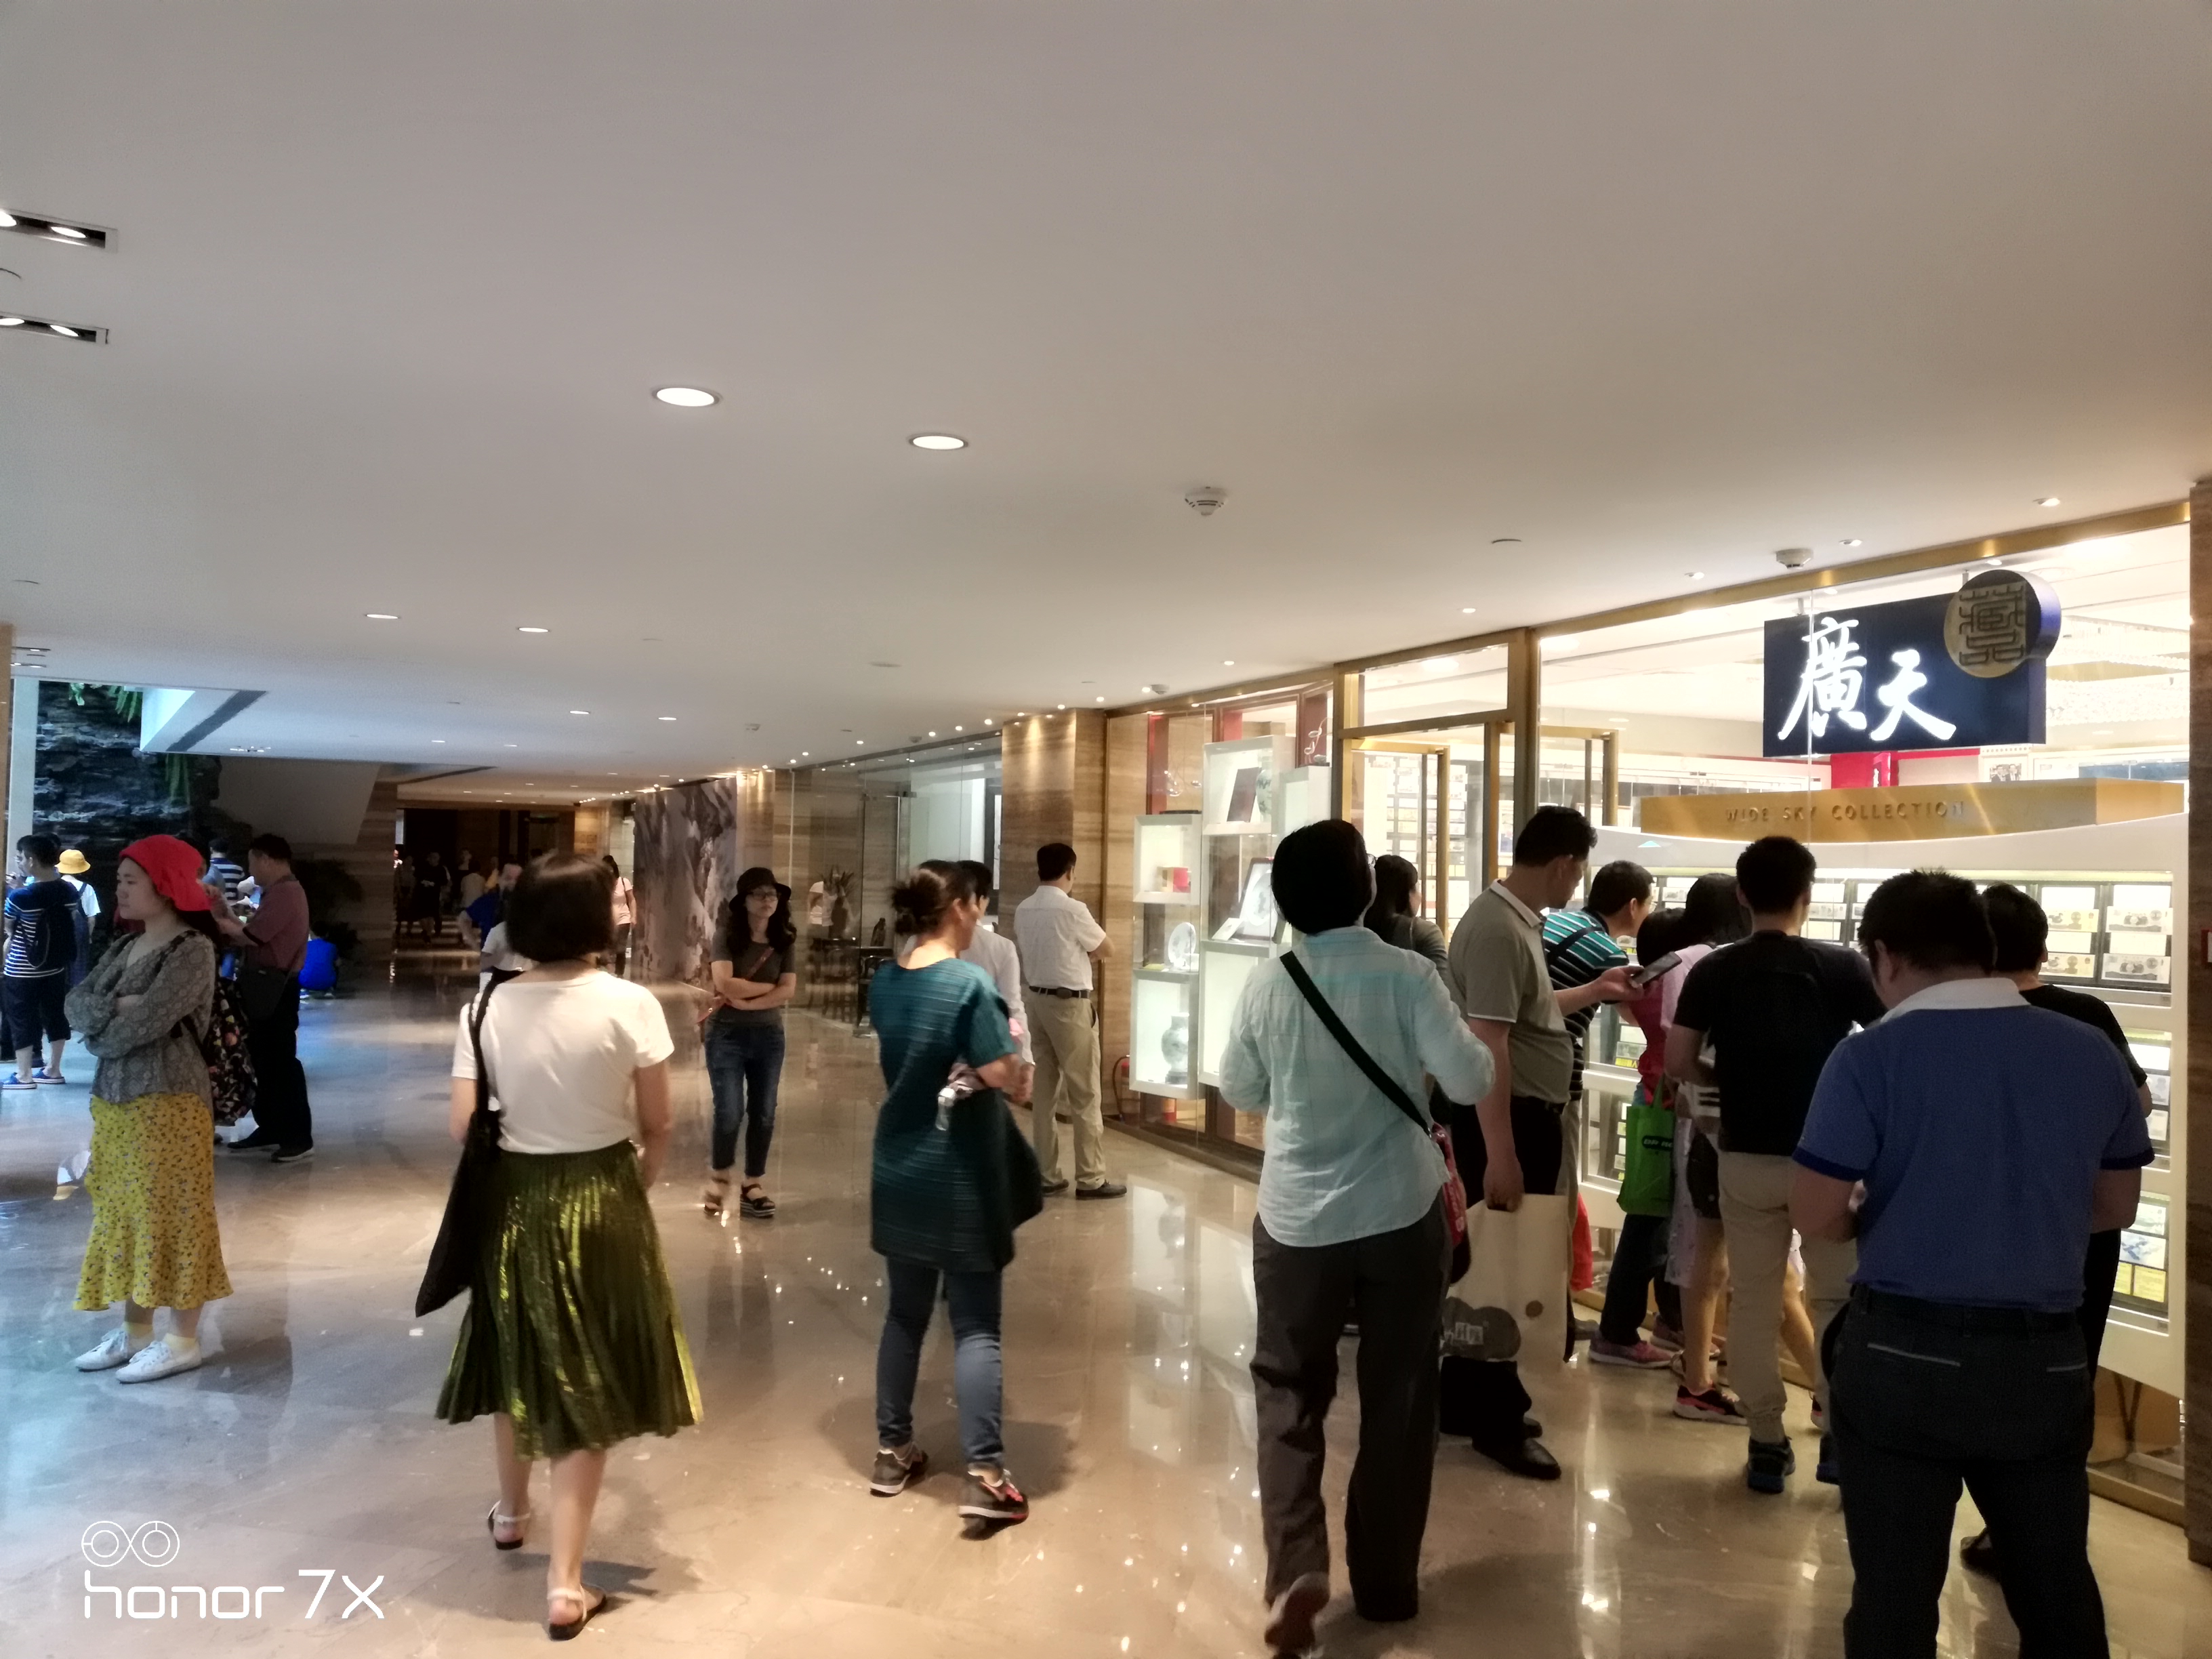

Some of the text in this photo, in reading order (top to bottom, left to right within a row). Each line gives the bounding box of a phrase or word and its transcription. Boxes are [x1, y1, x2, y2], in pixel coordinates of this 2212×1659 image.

[1726, 801, 1965, 821] WIDE SKY COLLECTION
